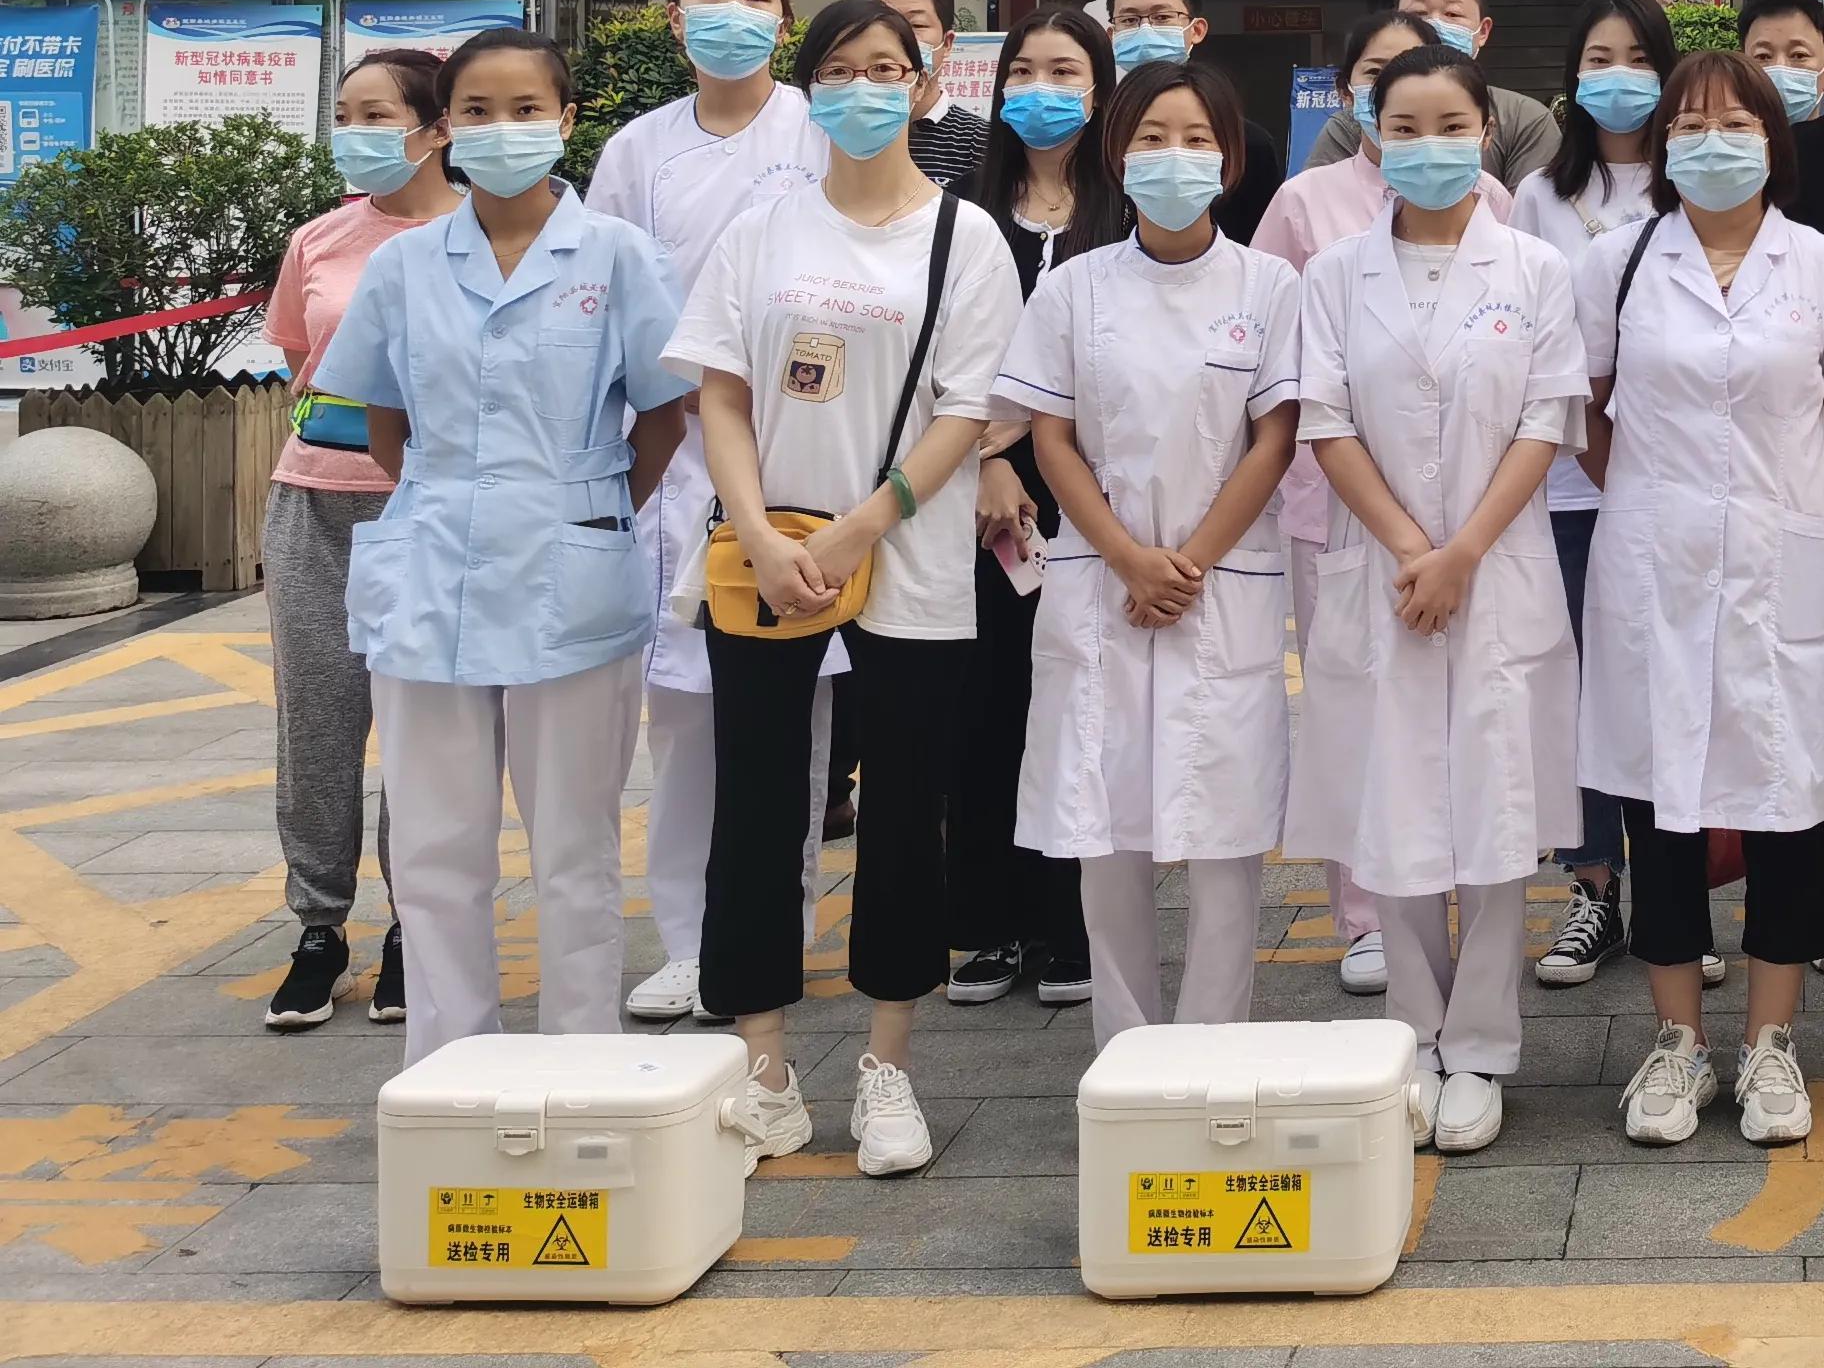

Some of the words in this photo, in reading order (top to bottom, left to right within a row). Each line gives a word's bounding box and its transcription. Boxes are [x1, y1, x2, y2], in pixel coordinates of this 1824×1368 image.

[0, 35, 82, 56] 付不带卡
[12, 58, 76, 78] 刷医保
[174, 50, 297, 67] 新型冠状病毒疫苗
[197, 69, 274, 86] 知情同意书
[940, 80, 994, 98] 应处置区
[1296, 90, 1346, 109] 新冠疫
[794, 273, 830, 285] JUICY
[832, 279, 886, 295] BERRIES
[767, 289, 817, 306] SWEET
[819, 297, 855, 314] AND
[858, 304, 905, 325] SOUR
[795, 348, 833, 362] TOMATO
[38, 359, 74, 372] 支付宝
[1225, 1174, 1302, 1193] 生物安全运输箱
[523, 1192, 599, 1210] 生物安全运输箱
[1147, 1226, 1212, 1248] 送检专用
[447, 1241, 511, 1263] 送检专用
